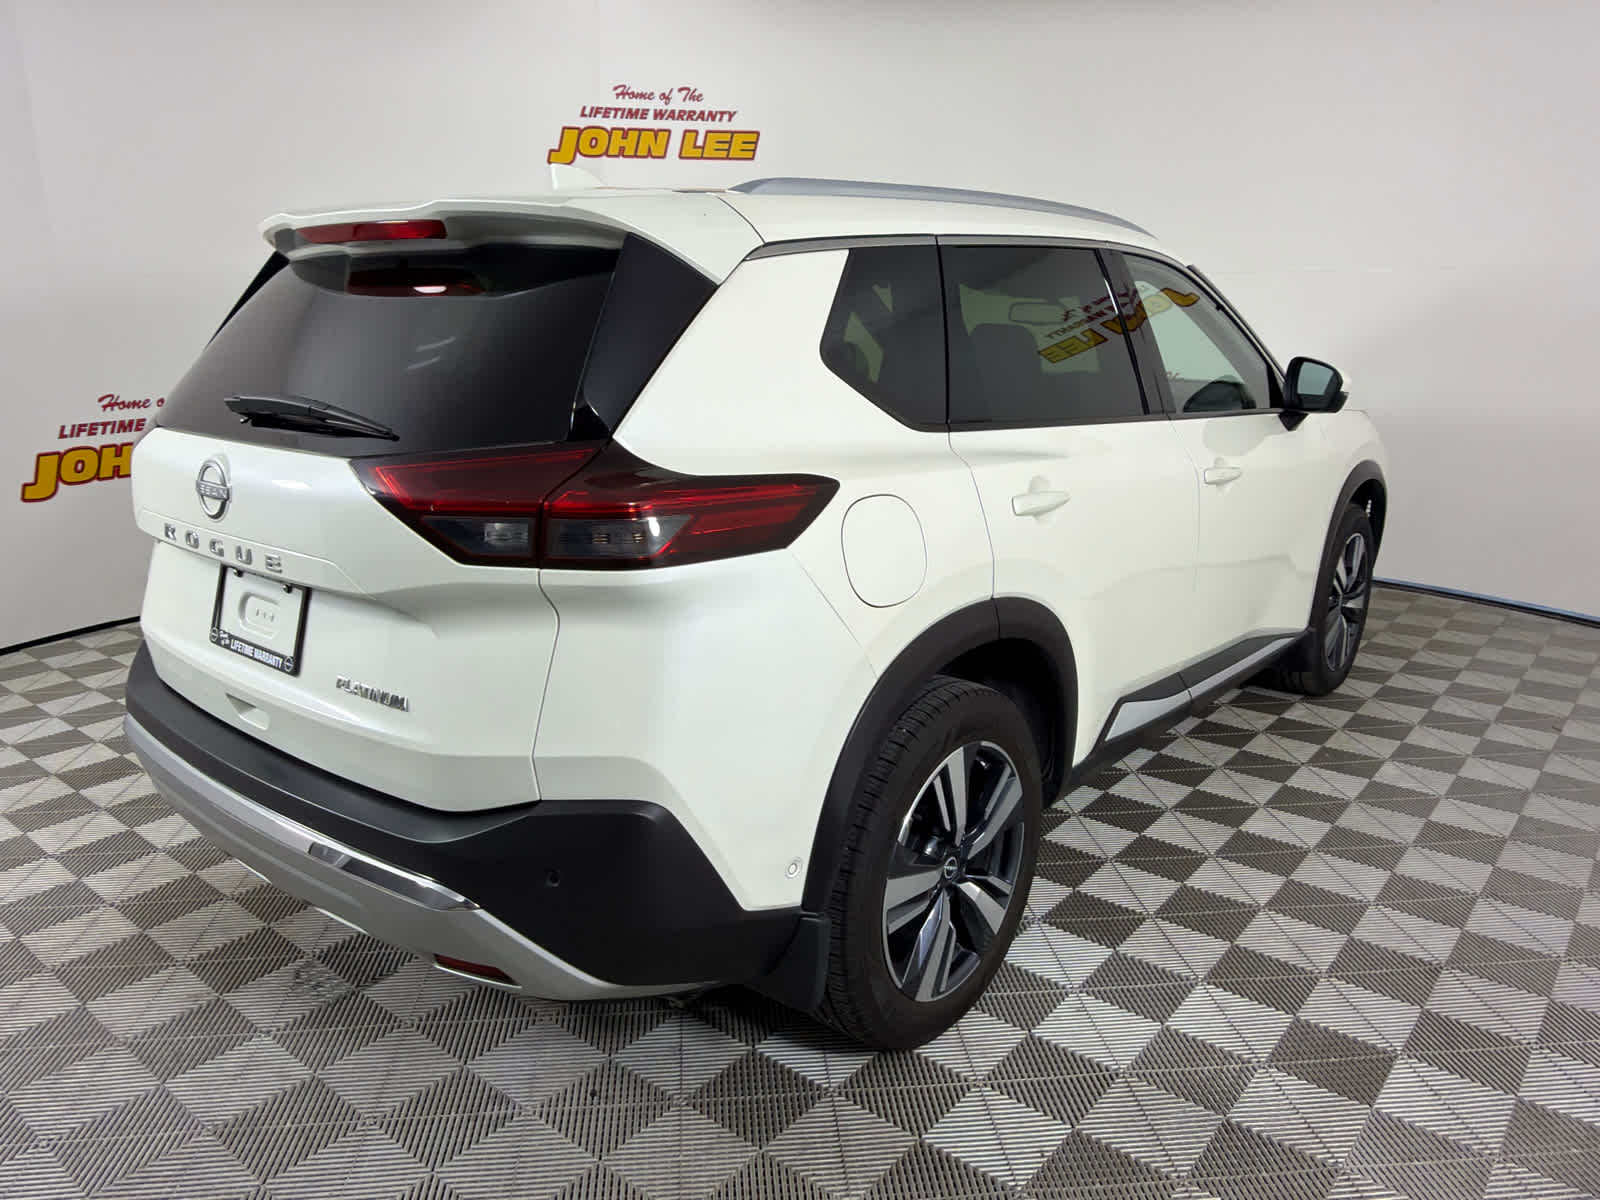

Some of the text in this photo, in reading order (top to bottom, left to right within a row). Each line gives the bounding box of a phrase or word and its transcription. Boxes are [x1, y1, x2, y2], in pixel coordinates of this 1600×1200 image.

[612, 84, 704, 104] Home of The
[580, 105, 737, 122] LIFETIME WARRANTY
[547, 125, 760, 165] JOHN LEE
[97, 393, 165, 412] Home o
[57, 418, 147, 439] LIFETIME
[20, 442, 134, 503] JOH
[164, 522, 283, 574] ROGUE
[230, 638, 283, 669] LIFETIME WARRANTY
[336, 675, 409, 712] PLATINUM
